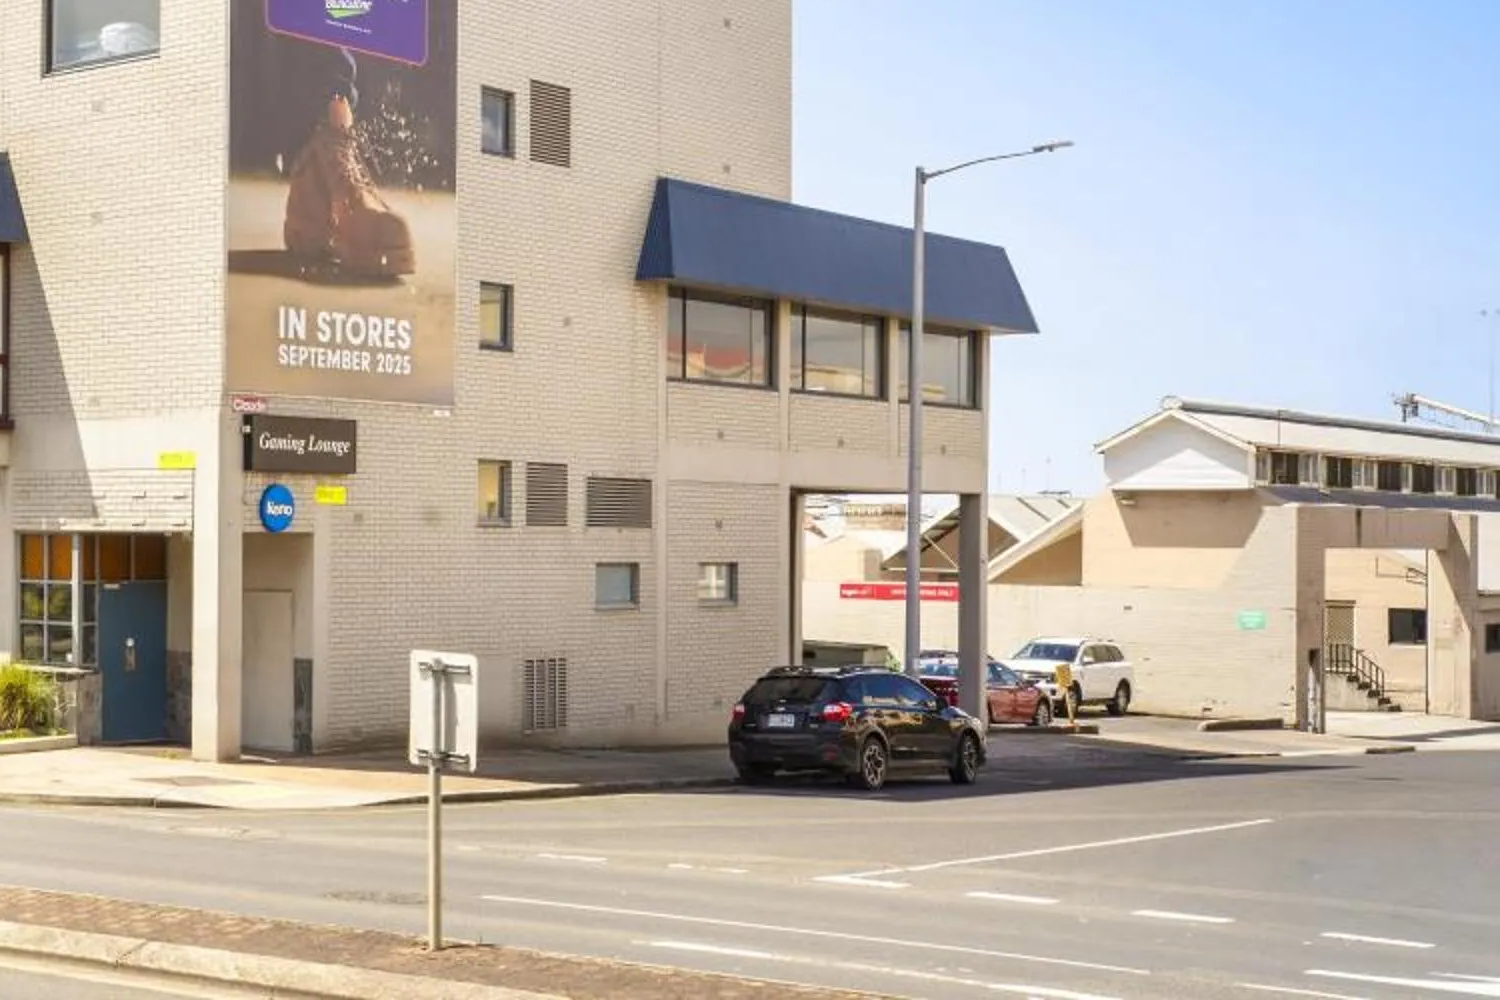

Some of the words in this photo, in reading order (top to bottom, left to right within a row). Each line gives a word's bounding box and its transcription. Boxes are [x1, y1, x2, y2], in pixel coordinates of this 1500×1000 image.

[278, 305, 307, 340] IN
[316, 311, 413, 350] STORES
[278, 344, 371, 373] SEPTEMBER
[376, 353, 412, 375] 2025
[259, 432, 306, 455] Gaming
[307, 435, 351, 457] Lounge
[266, 500, 293, 517] Keno
